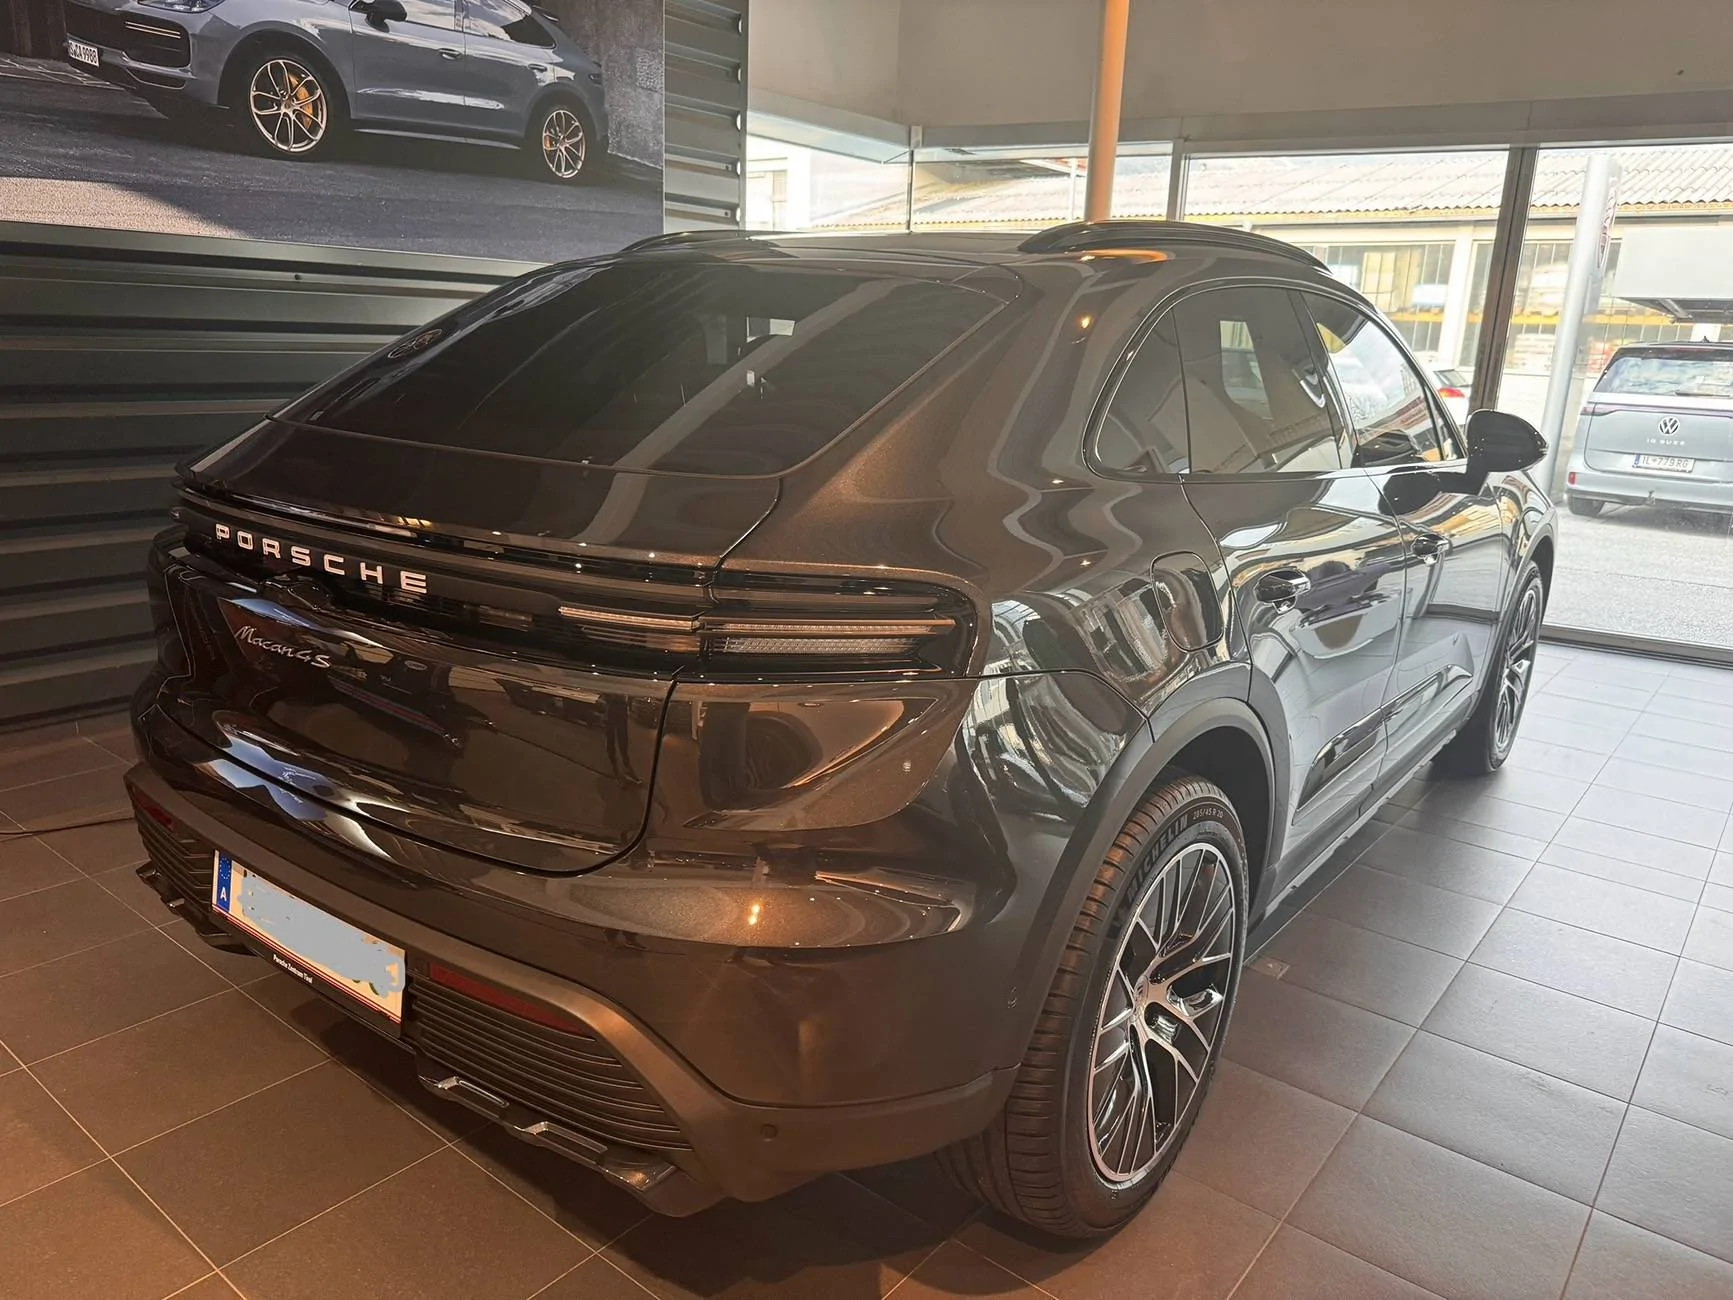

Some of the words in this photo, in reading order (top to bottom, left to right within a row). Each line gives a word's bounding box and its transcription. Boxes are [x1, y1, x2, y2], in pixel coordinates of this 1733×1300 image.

[215, 523, 427, 594] PORSCHE
[234, 625, 294, 658] Macan
[1127, 814, 1188, 904] MICHELIN
[220, 886, 227, 902] A
